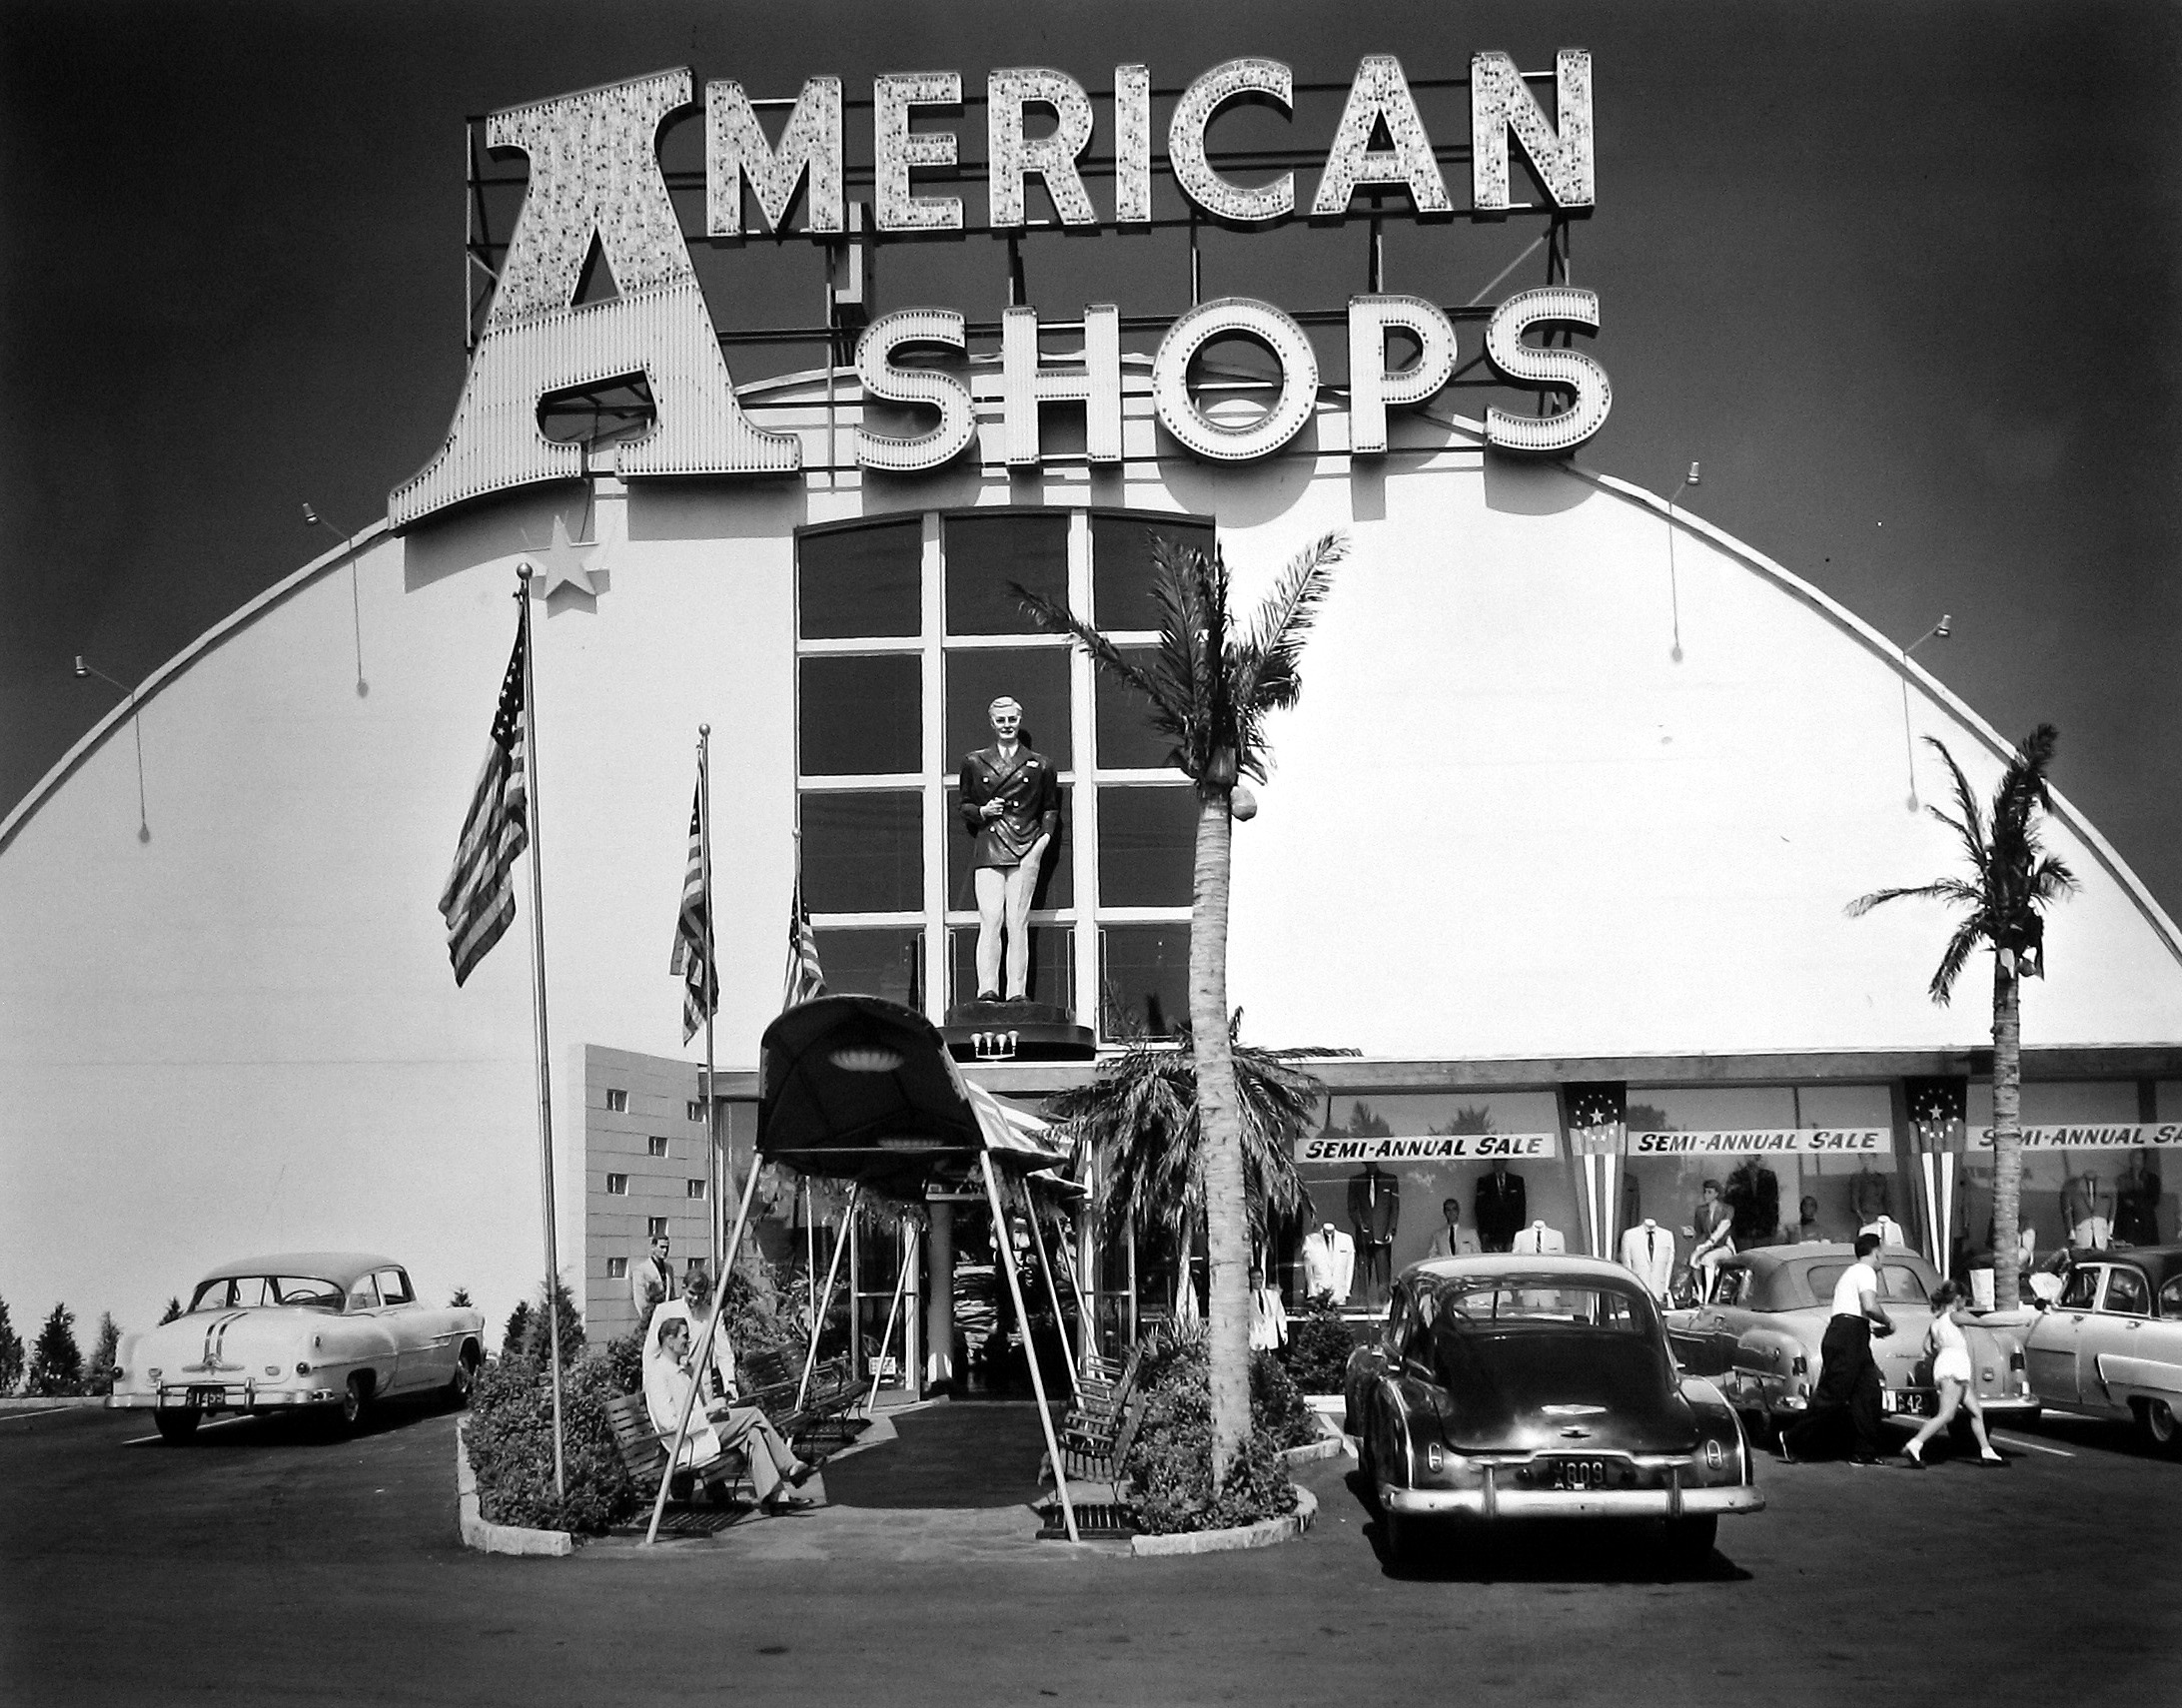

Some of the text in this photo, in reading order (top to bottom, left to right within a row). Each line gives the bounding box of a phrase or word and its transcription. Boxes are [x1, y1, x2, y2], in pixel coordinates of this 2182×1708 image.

[388, 48, 1596, 530] AMERICAN
[854, 287, 1613, 474] SHOPS
[1305, 1137, 1544, 1159] SEMI-ANNUAL SALE
[1637, 1131, 1878, 1152] SEMI-ANNUAL SALE
